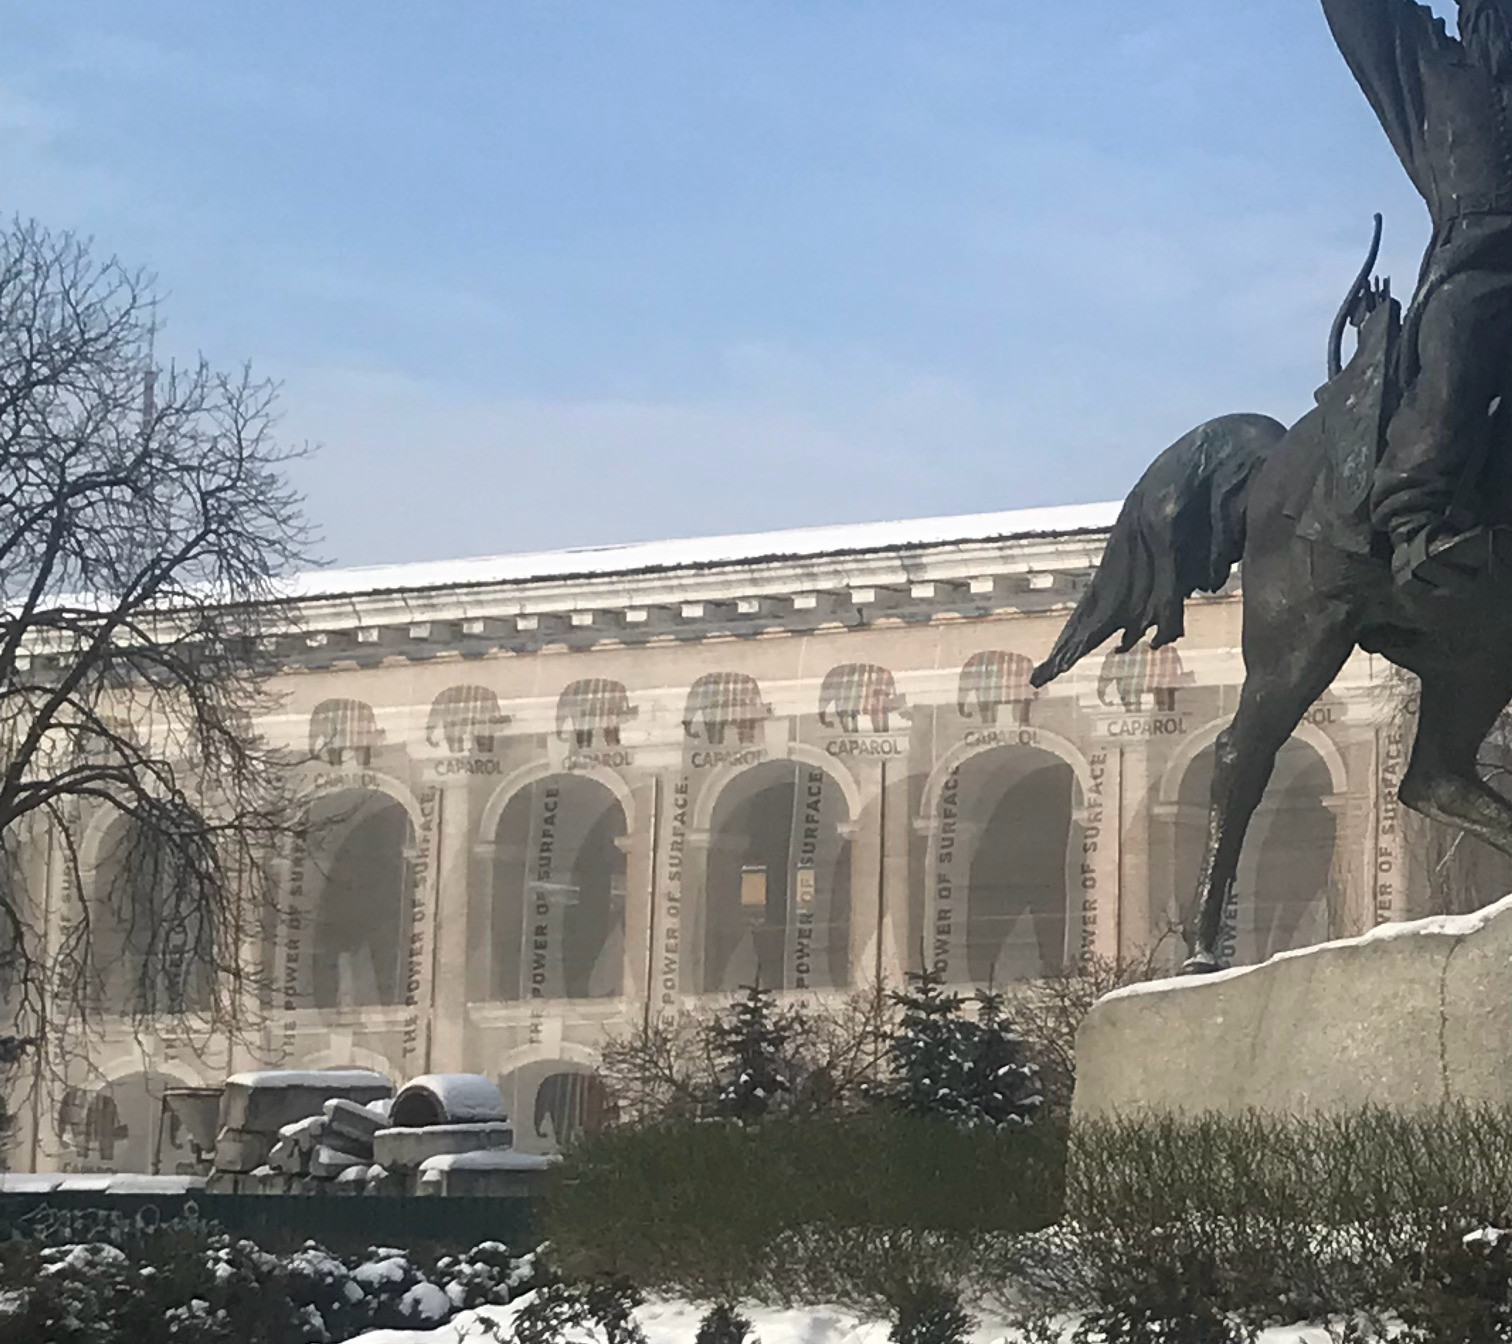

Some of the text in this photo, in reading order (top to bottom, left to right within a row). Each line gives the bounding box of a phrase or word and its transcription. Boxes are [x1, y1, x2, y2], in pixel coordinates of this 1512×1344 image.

[1107, 718, 1187, 736] CAPAROL
[825, 739, 902, 756] CAPAROL
[434, 759, 504, 775] CAPAROL
[1081, 745, 1108, 854] SURFACE.
[1379, 846, 1393, 873] OF
[800, 876, 815, 902] OF
[937, 872, 952, 899] OF
[1080, 863, 1097, 889] OF
[412, 898, 425, 922] OF
[667, 893, 681, 918] OF
[531, 923, 549, 998] POWER
[795, 912, 814, 989] POWER
[284, 938, 300, 1010] POWER
[404, 932, 424, 1007] POWER
[662, 927, 679, 1004] POWER
[403, 1016, 418, 1059] THE
